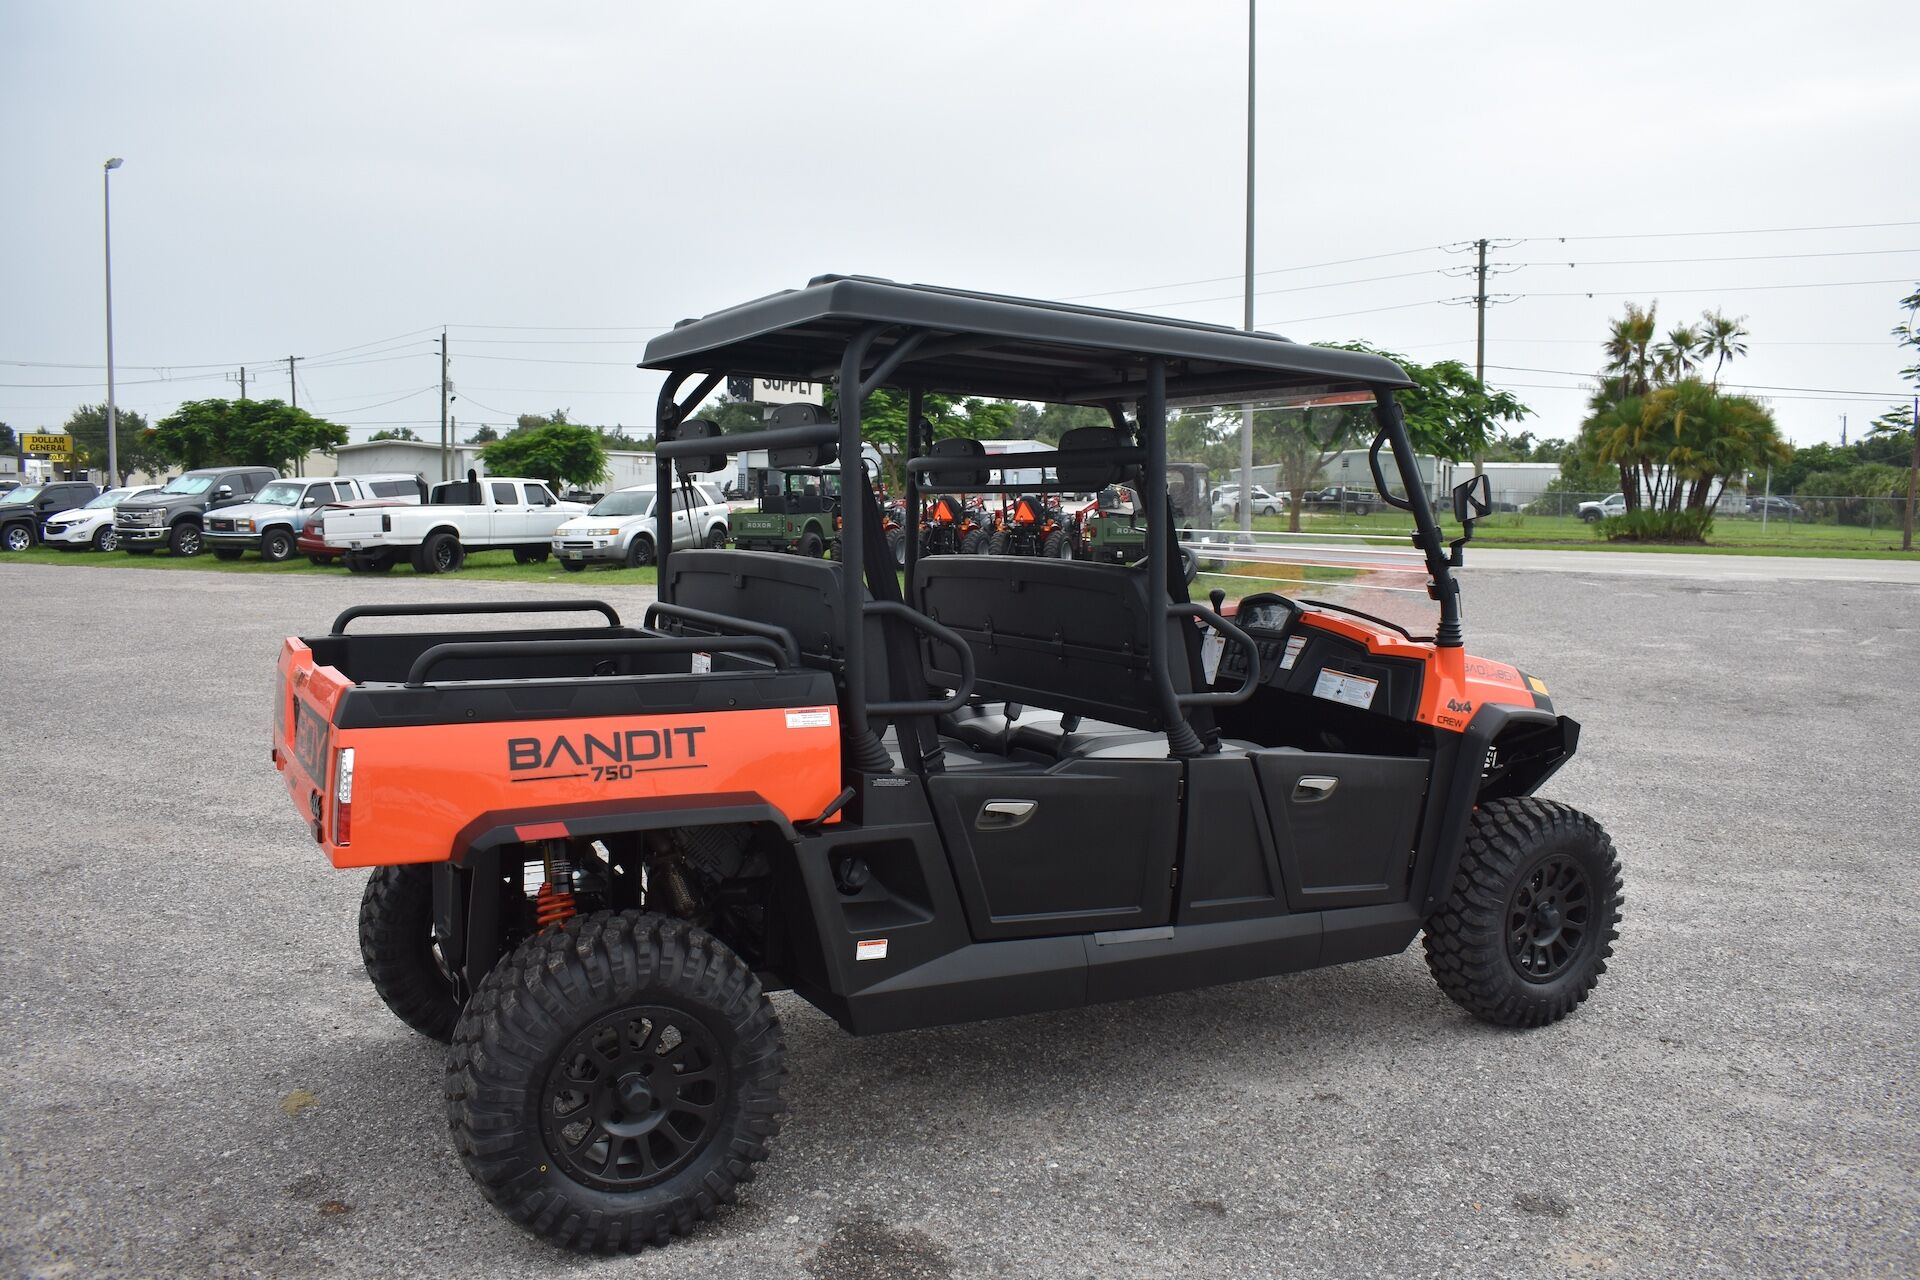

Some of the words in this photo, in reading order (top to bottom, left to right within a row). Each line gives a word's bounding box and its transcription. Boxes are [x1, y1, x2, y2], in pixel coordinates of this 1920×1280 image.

[763, 378, 812, 395] SUPPLY
[29, 444, 67, 452] GENERAL
[32, 436, 65, 444] DOLLAR
[1446, 698, 1472, 714] 4x4
[1437, 714, 1464, 728] CREW
[507, 726, 706, 771] BANDIT
[590, 764, 633, 782] 750
